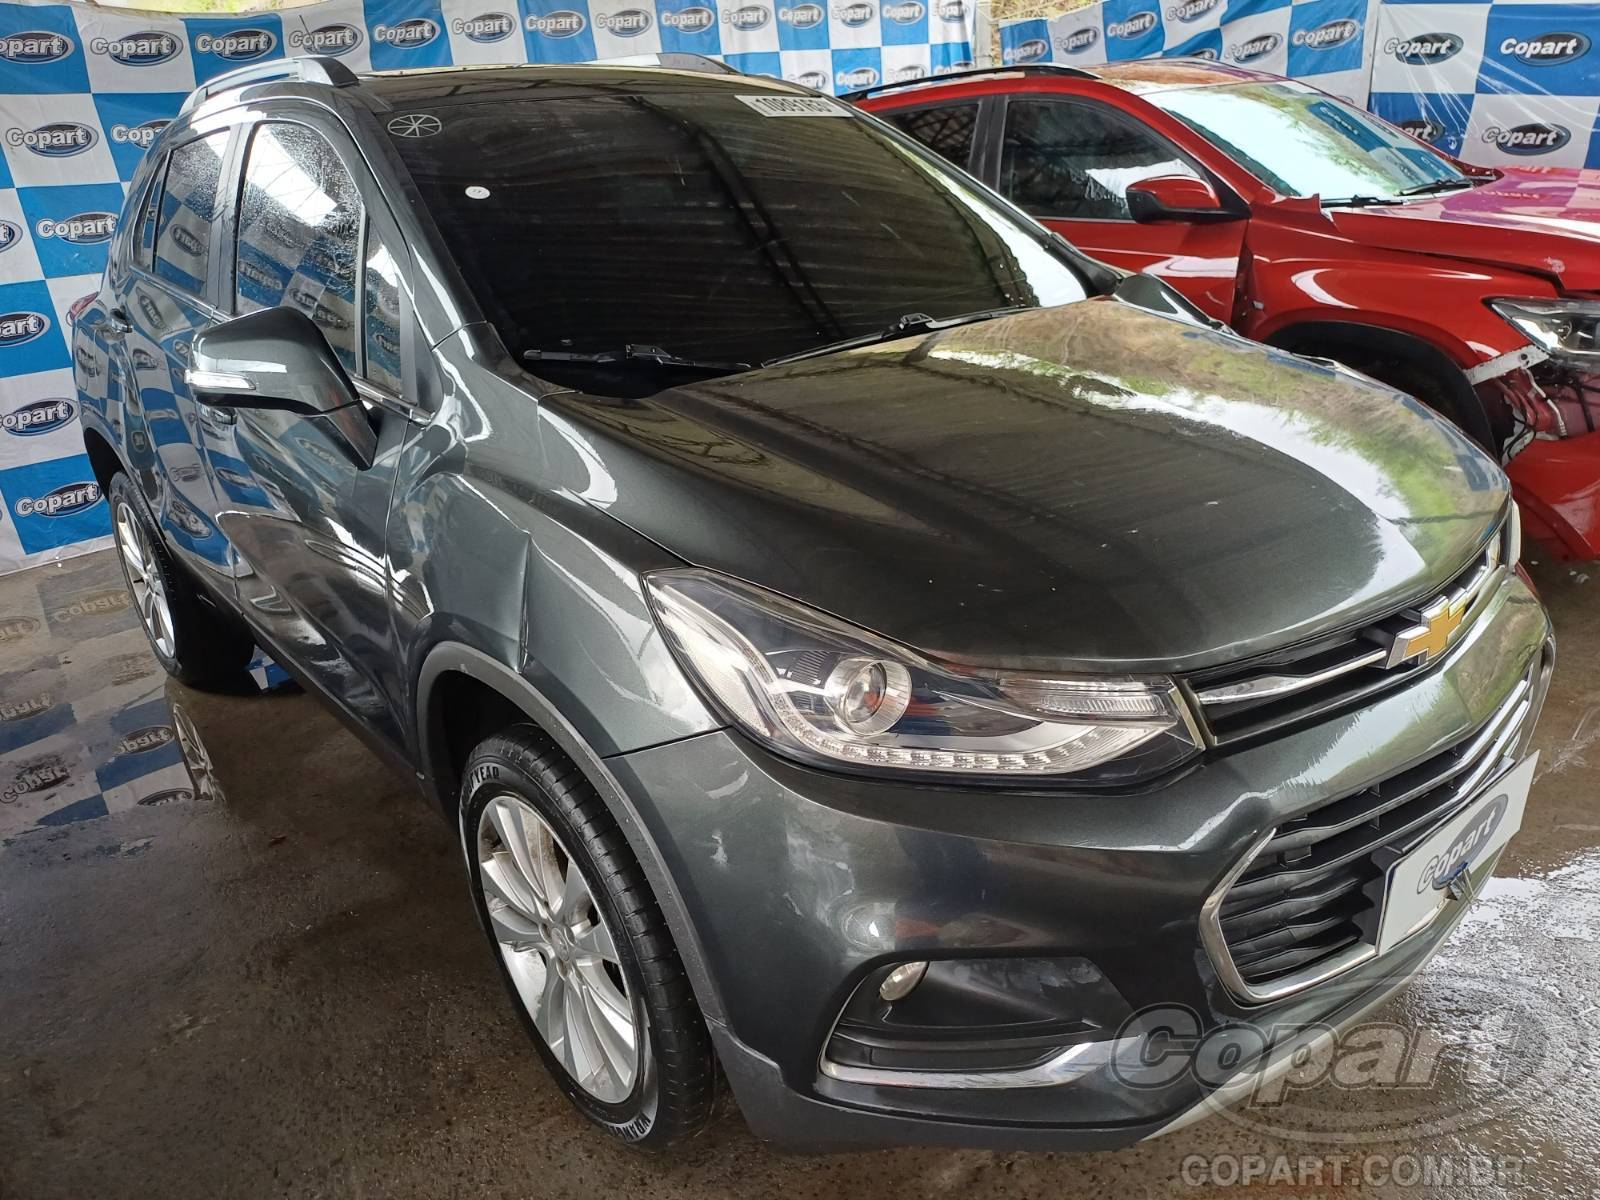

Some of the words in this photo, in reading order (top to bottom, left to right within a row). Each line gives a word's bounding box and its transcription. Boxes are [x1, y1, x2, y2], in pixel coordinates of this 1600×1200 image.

[596, 12, 646, 31] Copart
[661, 11, 708, 27] Copart
[721, 8, 765, 25] Copart
[779, 7, 819, 24] Copart
[832, 6, 871, 22] Copart
[882, 5, 920, 20] Copart
[374, 21, 432, 42] Copart
[452, 17, 509, 35] Copart
[526, 15, 580, 32] Copart
[1106, 14, 1153, 38] Copart
[196, 34, 268, 56] Copart
[289, 29, 353, 51] Copart
[1054, 29, 1095, 50] Copart
[1292, 22, 1355, 47] Copart
[90, 35, 171, 59] Copart
[1384, 37, 1452, 58] Copart
[1500, 37, 1578, 58] Copart
[837, 70, 875, 88] Copart
[6, 127, 88, 150] Copart
[1481, 126, 1558, 147] Copart
[37, 216, 118, 240] Copart
[0, 401, 68, 431] opart
[15, 483, 98, 515] Copart
[1416, 808, 1495, 894] Copart
